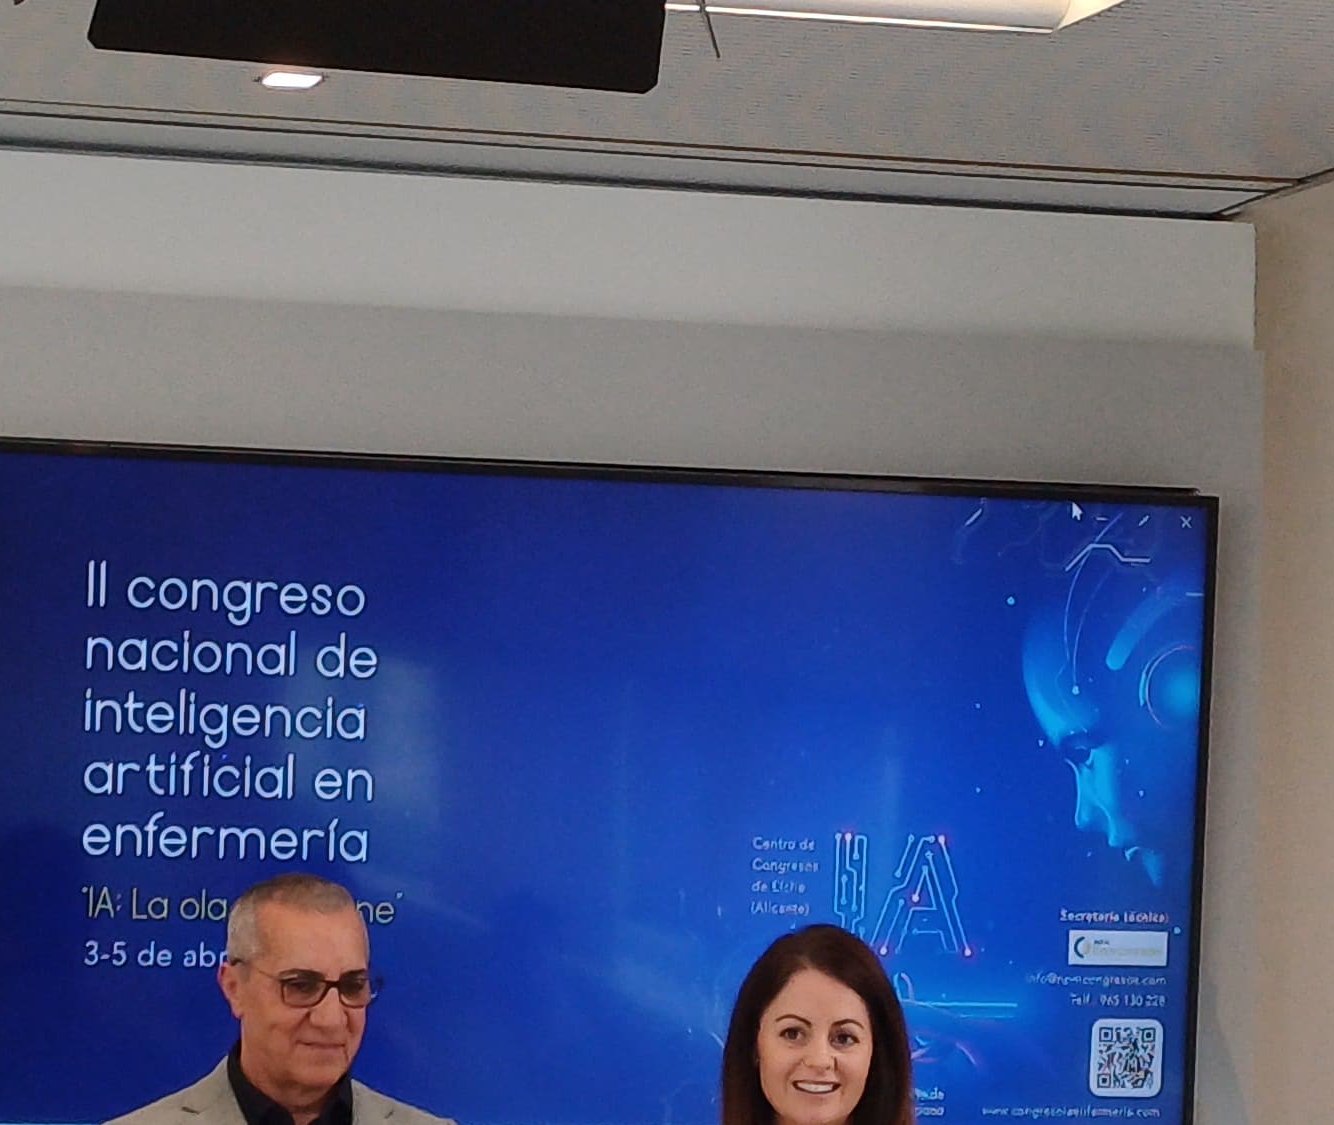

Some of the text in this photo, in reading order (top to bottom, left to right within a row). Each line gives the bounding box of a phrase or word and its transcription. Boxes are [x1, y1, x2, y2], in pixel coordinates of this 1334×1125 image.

[85, 560, 367, 626] II congreso
[85, 629, 379, 680] nacional de
[82, 686, 367, 749] inteligencia
[83, 750, 374, 802] artificial en
[81, 811, 369, 864] enfermería
[751, 836, 796, 851] Centro
[132, 887, 169, 920] La
[179, 887, 228, 921] ola
[83, 939, 229, 968] 3-5 de abr
